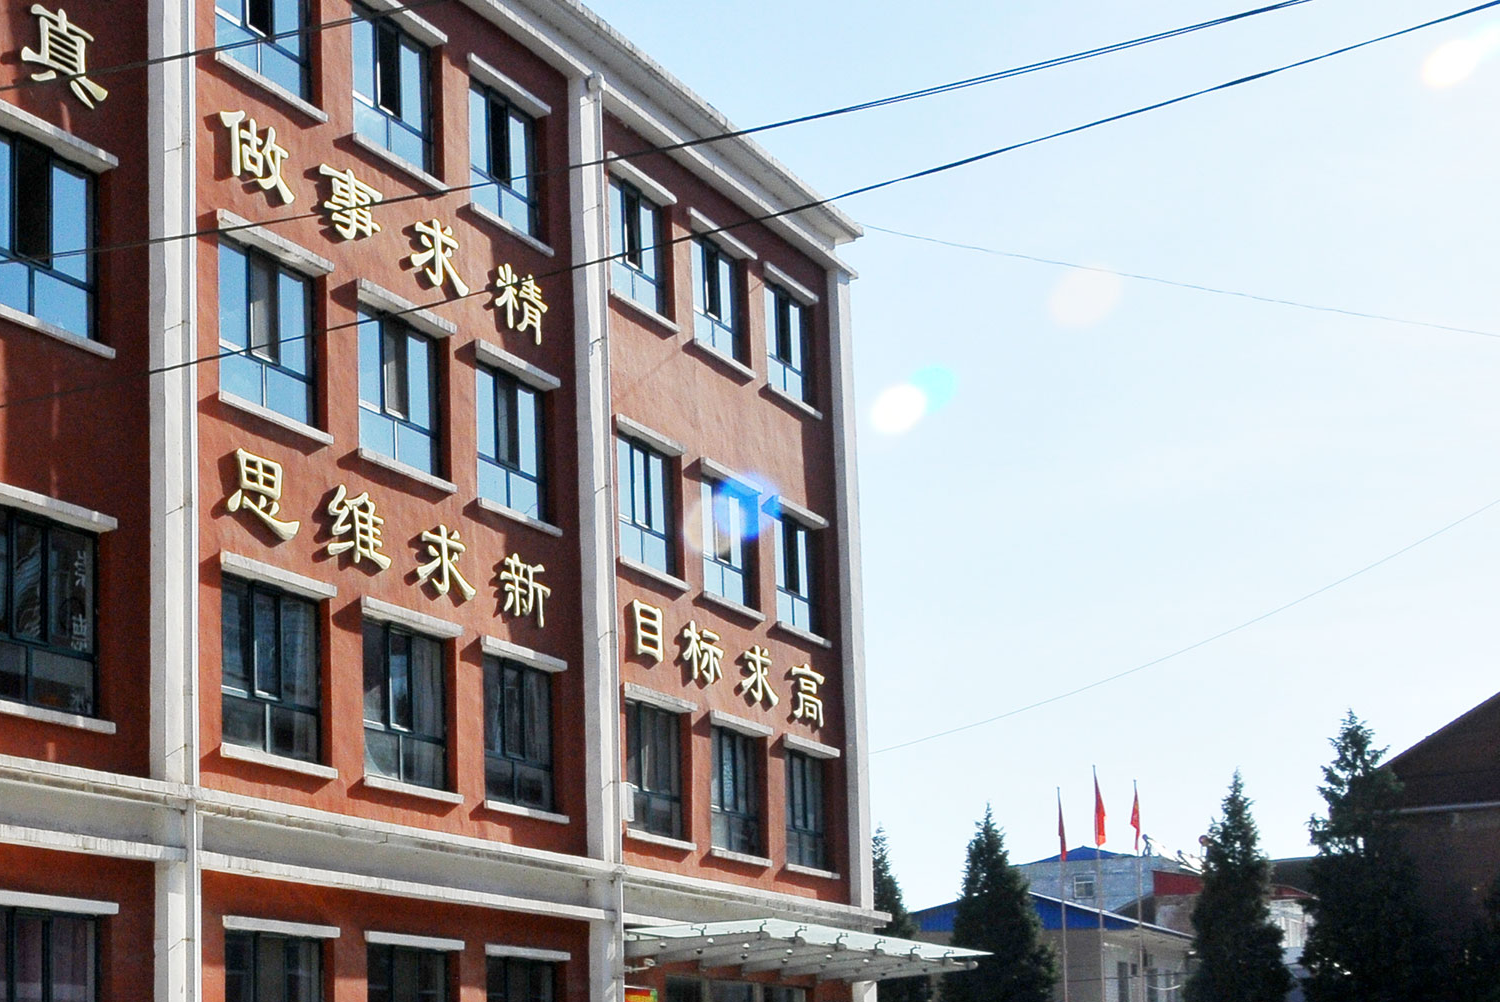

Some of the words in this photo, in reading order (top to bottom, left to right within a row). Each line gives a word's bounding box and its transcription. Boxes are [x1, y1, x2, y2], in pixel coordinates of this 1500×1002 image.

[219, 109, 550, 346] 做事求精
[226, 447, 552, 629] 思维求新
[632, 598, 826, 729] 目标求高
